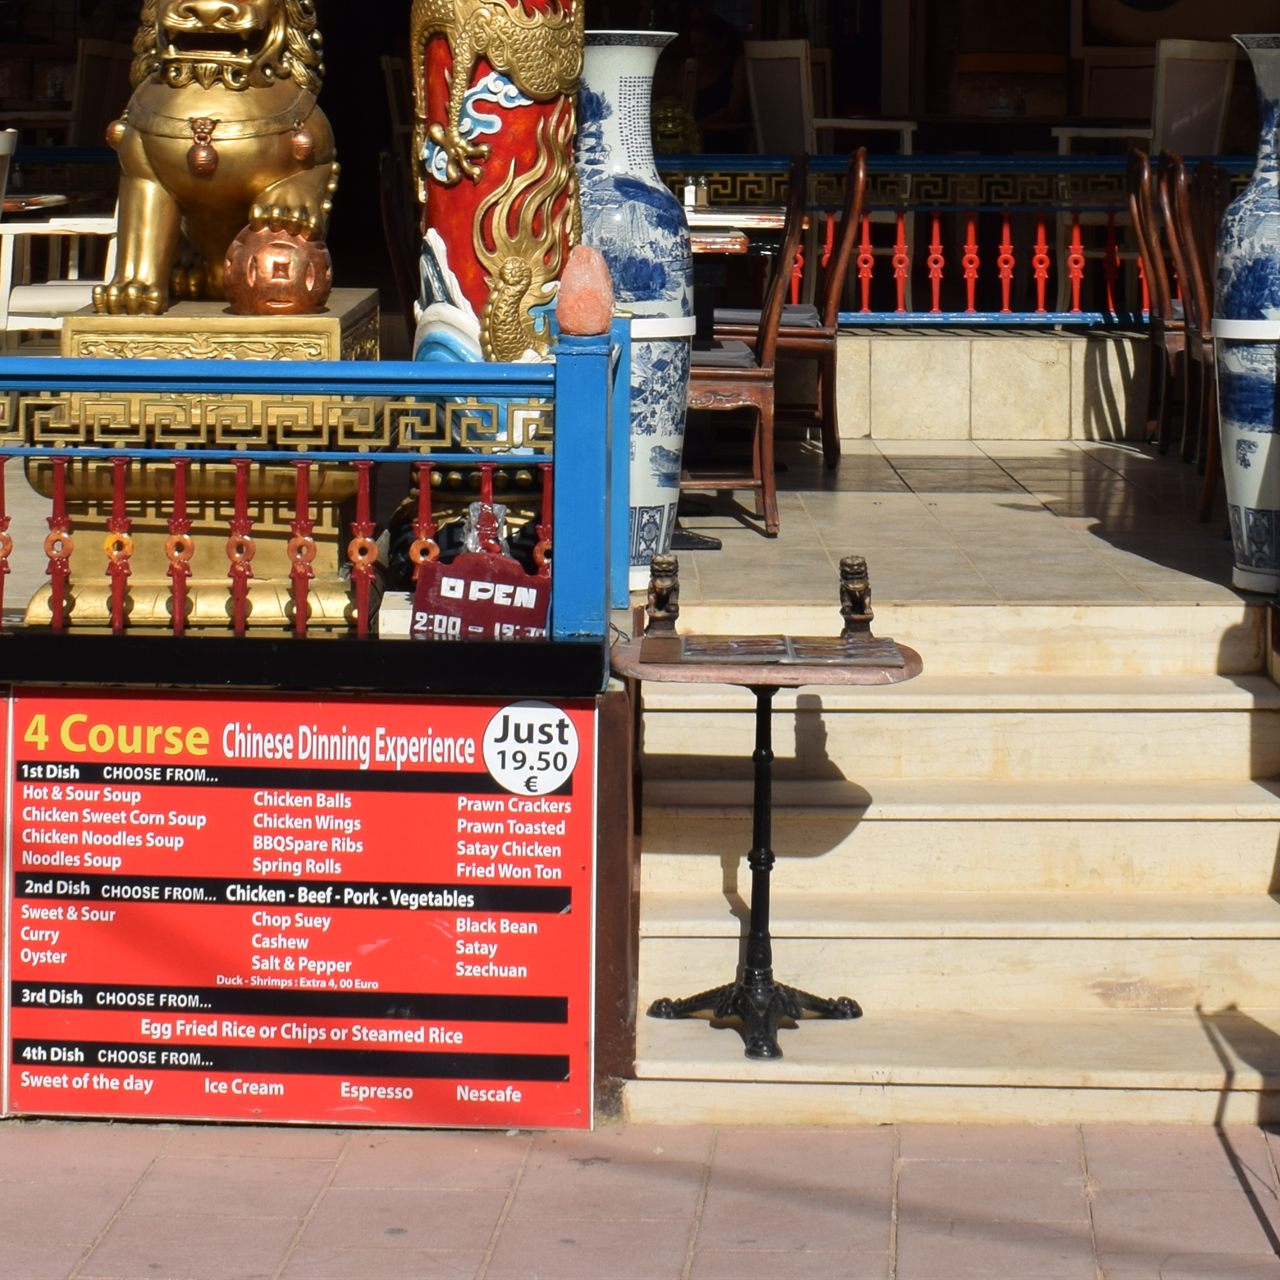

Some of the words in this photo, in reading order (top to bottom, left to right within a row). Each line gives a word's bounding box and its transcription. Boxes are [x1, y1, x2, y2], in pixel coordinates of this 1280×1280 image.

[440, 577, 537, 608] OPEN
[494, 715, 569, 744] Just
[24, 714, 48, 751] 4
[60, 713, 210, 756] Course
[223, 722, 293, 759] Chinese
[299, 725, 370, 769] Dinning
[376, 727, 475, 770] Experience
[496, 750, 568, 771] 19.50
[22, 765, 43, 777] 1st
[47, 765, 79, 778] Dish
[104, 767, 161, 780] CHOOSE
[167, 768, 218, 781] FROM...
[458, 797, 504, 811] Prawn
[508, 798, 571, 813] Crackers
[23, 807, 78, 822] Chicken
[83, 809, 126, 823] Sweet
[130, 810, 164, 824] Corn
[169, 811, 206, 829] Soup
[254, 836, 328, 853] BBQSpare
[332, 838, 363, 852] Ribs
[23, 851, 80, 866] Noodles
[84, 852, 121, 870] Soup
[390, 889, 474, 909] Vegetables
[252, 934, 308, 948] Cashew
[21, 948, 67, 965] Oyster
[456, 962, 527, 977] Szechuan
[341, 1082, 413, 1101] Espresso
[457, 1086, 521, 1102] Nescafe
